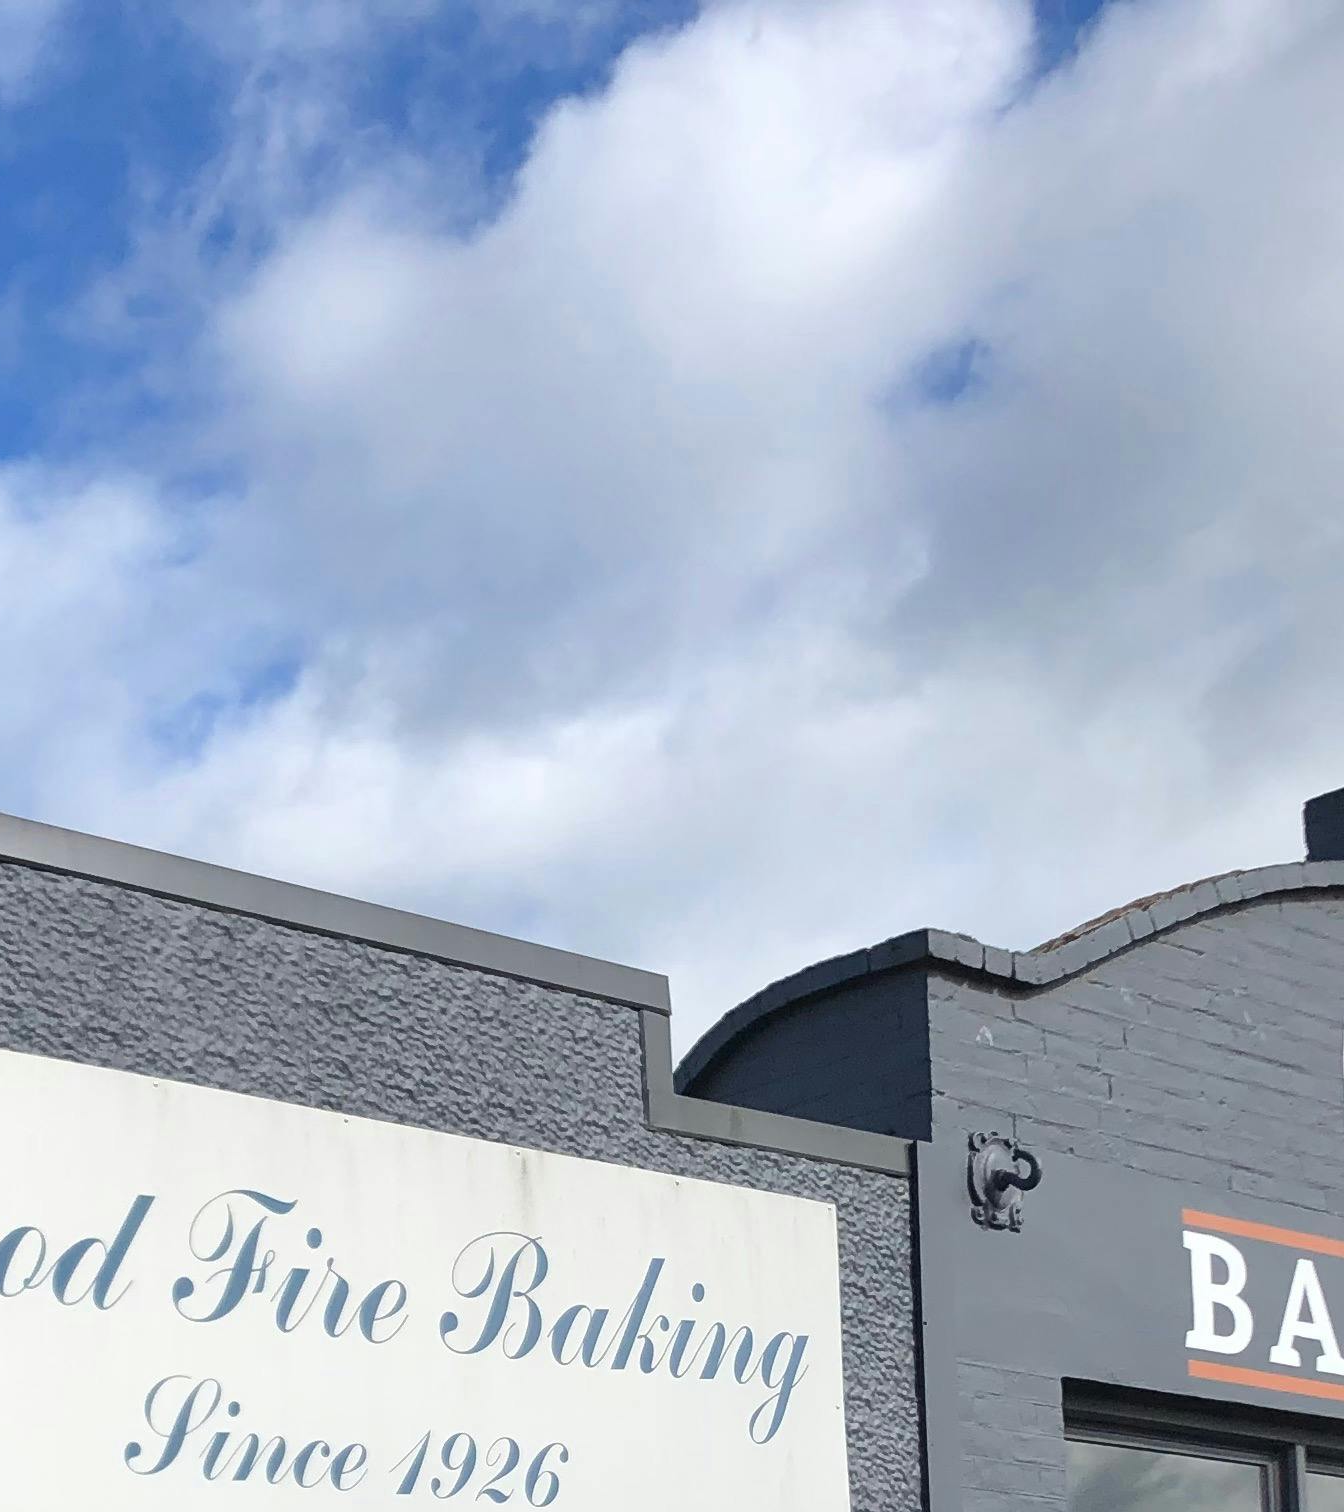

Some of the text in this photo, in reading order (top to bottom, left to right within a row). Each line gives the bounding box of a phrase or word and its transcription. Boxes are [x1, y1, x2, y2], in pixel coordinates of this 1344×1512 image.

[172, 1189, 409, 1344] Fire
[439, 1231, 810, 1446] Baking
[124, 1374, 570, 1508] Since 1926
